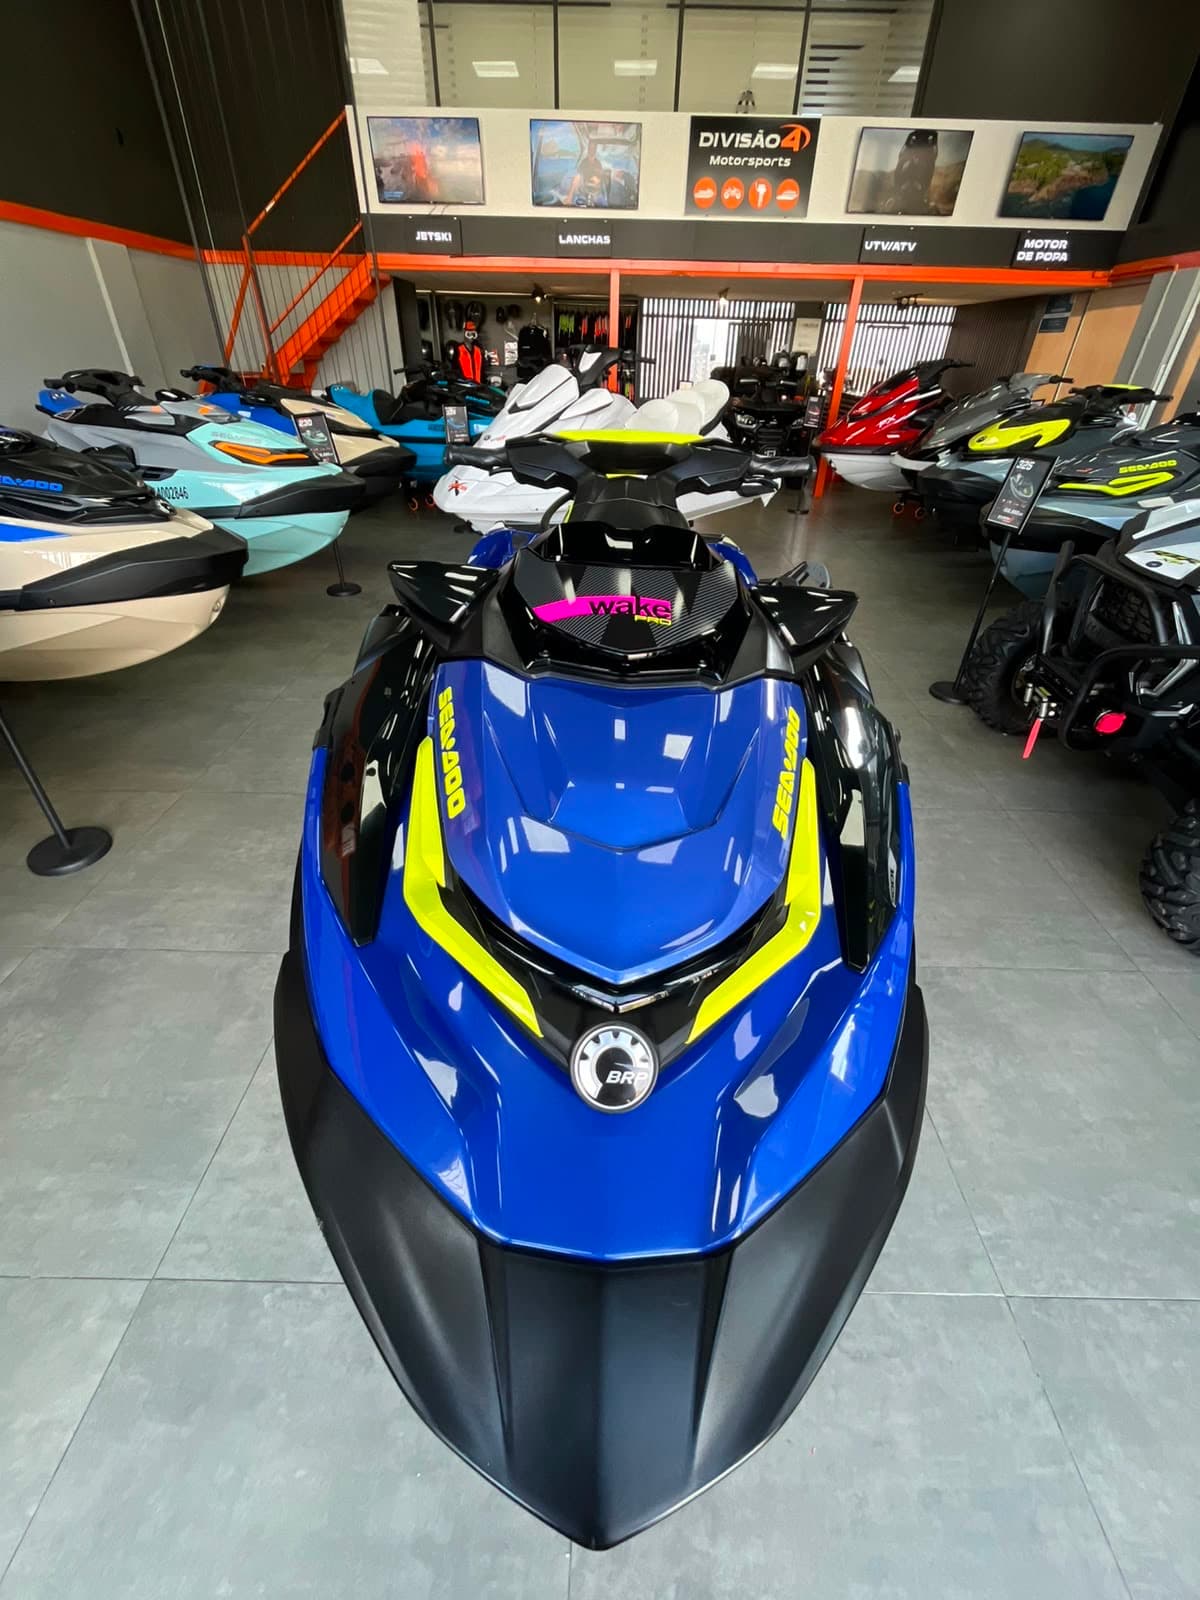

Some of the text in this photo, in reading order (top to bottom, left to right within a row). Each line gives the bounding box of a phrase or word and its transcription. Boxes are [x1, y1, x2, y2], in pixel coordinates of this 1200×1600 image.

[709, 155, 792, 168] Motorsports
[415, 231, 452, 241] JETSKI
[558, 234, 611, 245] LANCHAS
[864, 240, 917, 251] UTV/ATV
[1023, 238, 1068, 250] MOTOR
[1016, 251, 1068, 262] DE POPA
[589, 594, 672, 618] wake
[634, 614, 672, 627] PRO
[605, 1070, 649, 1085] BRP
